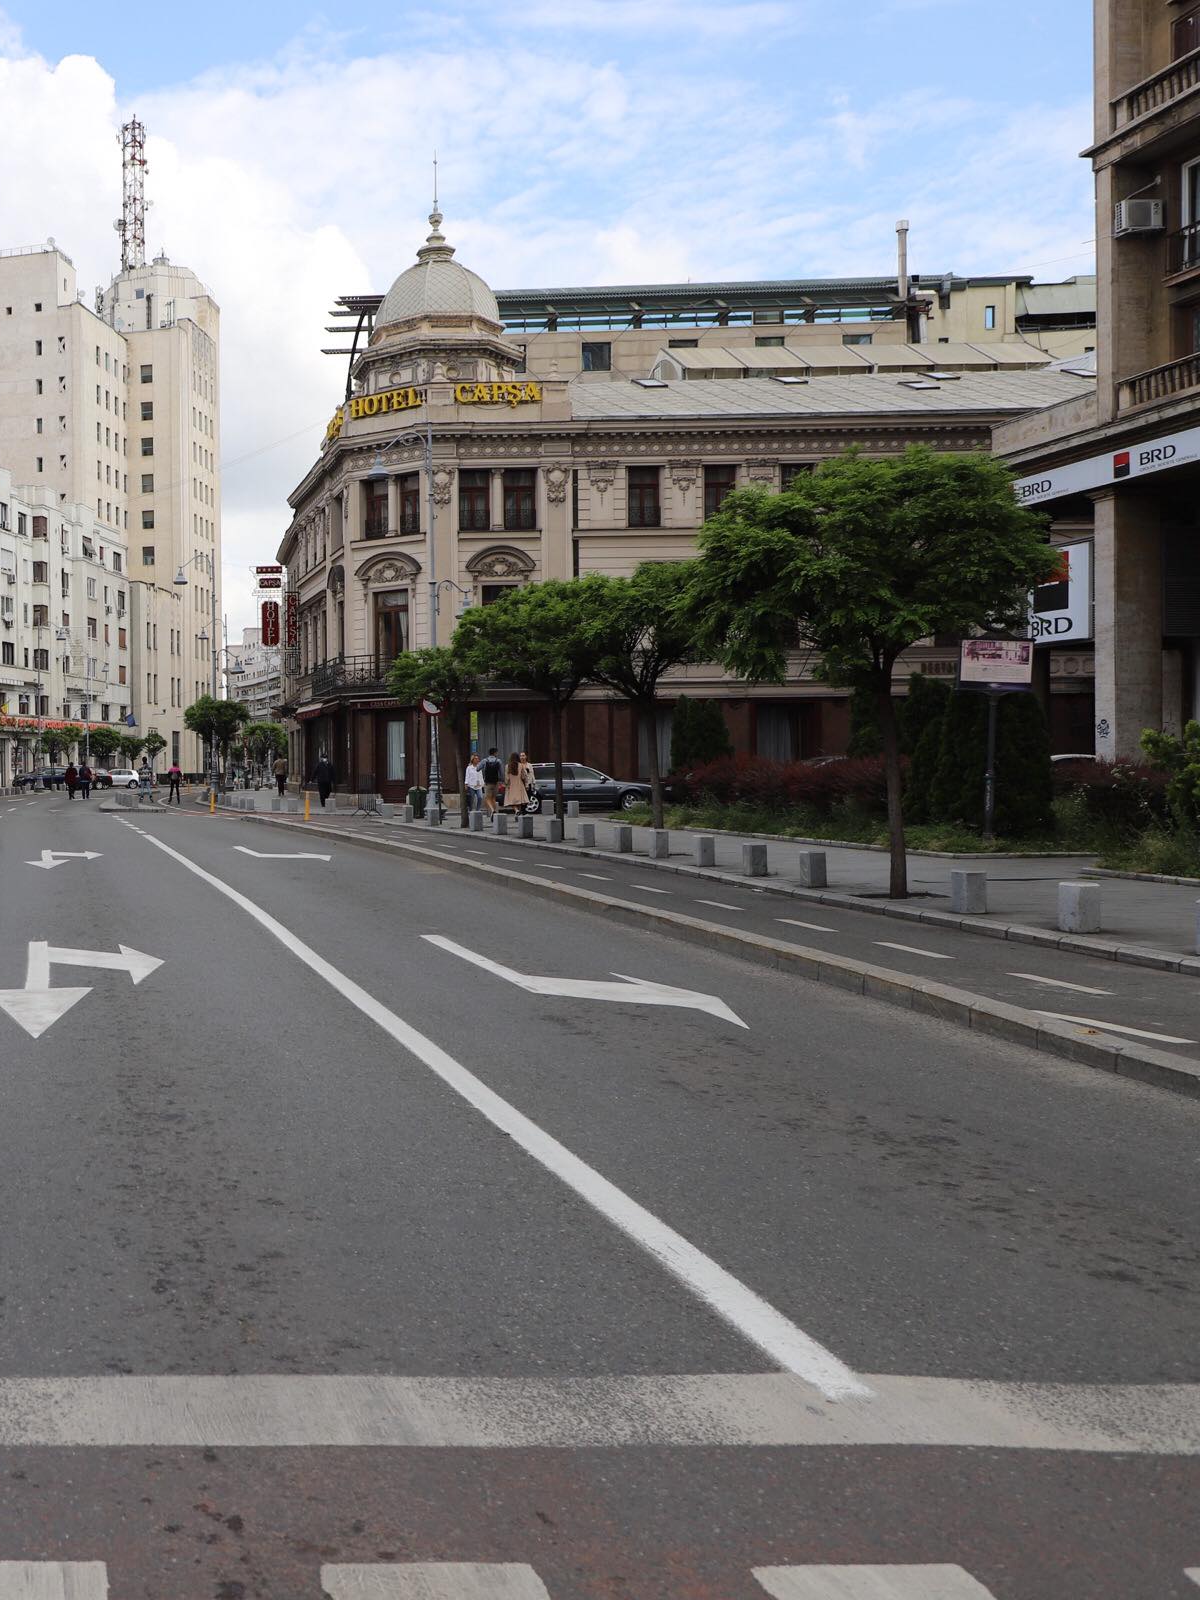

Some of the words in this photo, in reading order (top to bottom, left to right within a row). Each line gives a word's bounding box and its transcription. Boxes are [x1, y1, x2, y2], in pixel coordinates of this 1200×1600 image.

[350, 387, 423, 419] HOTEL
[1139, 444, 1176, 466] BRD
[1022, 479, 1052, 498] BRD
[266, 600, 275, 646] HOTEL
[1031, 616, 1073, 638] BRD
